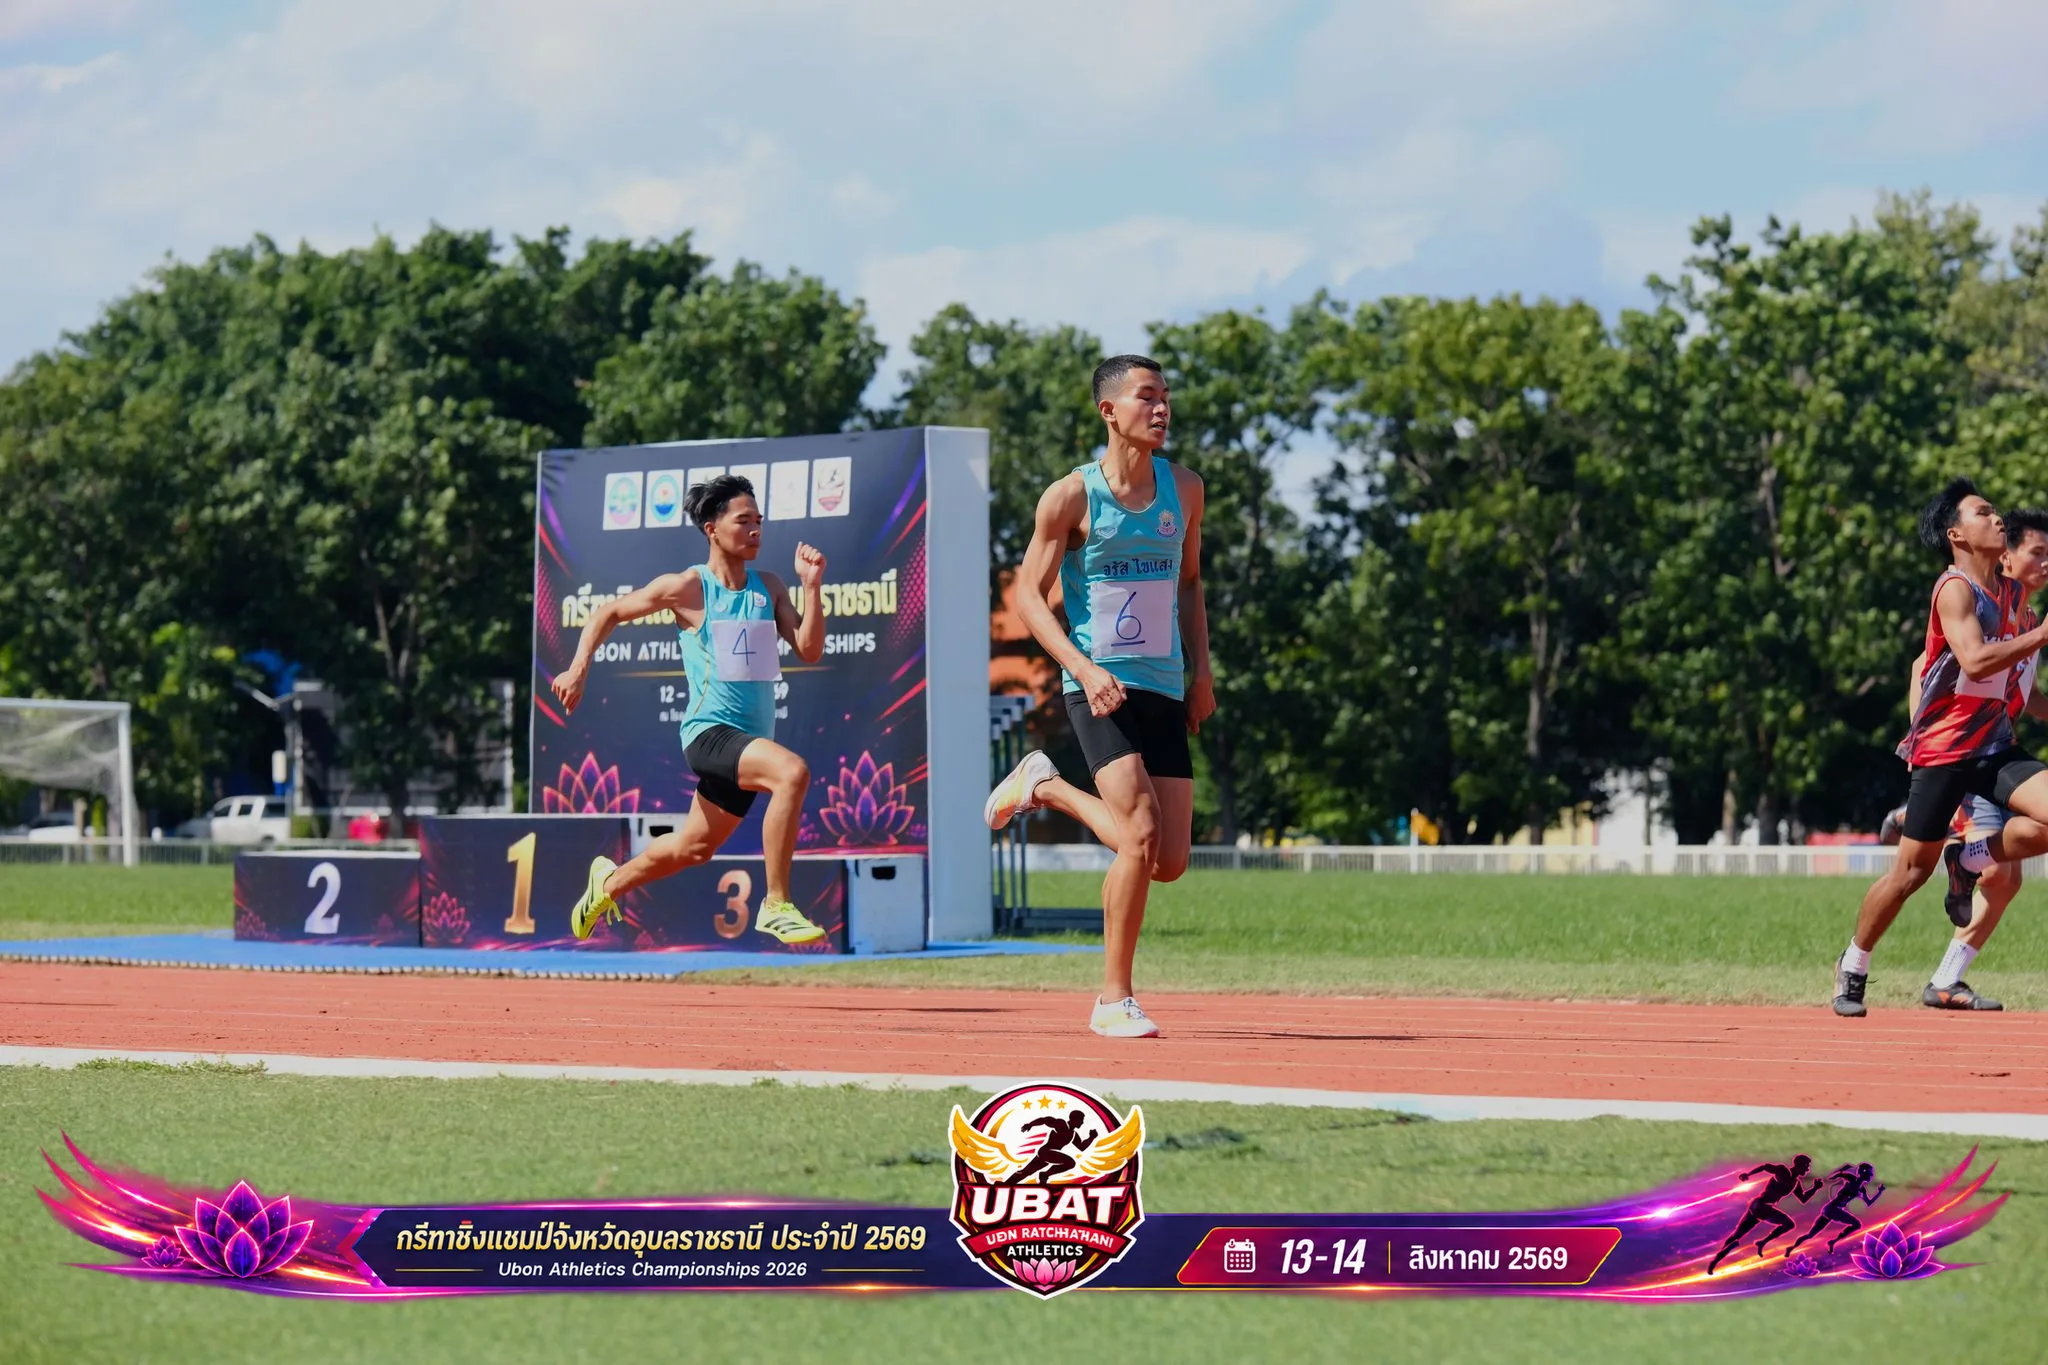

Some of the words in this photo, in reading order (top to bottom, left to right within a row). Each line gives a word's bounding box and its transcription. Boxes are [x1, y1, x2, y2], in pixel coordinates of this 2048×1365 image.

[1115, 591, 1142, 640] 6
[594, 642, 632, 663] BON
[732, 628, 757, 666] 4
[659, 685, 675, 703] 12
[304, 862, 341, 936] 2
[504, 832, 538, 936] 1
[714, 869, 752, 939] 3
